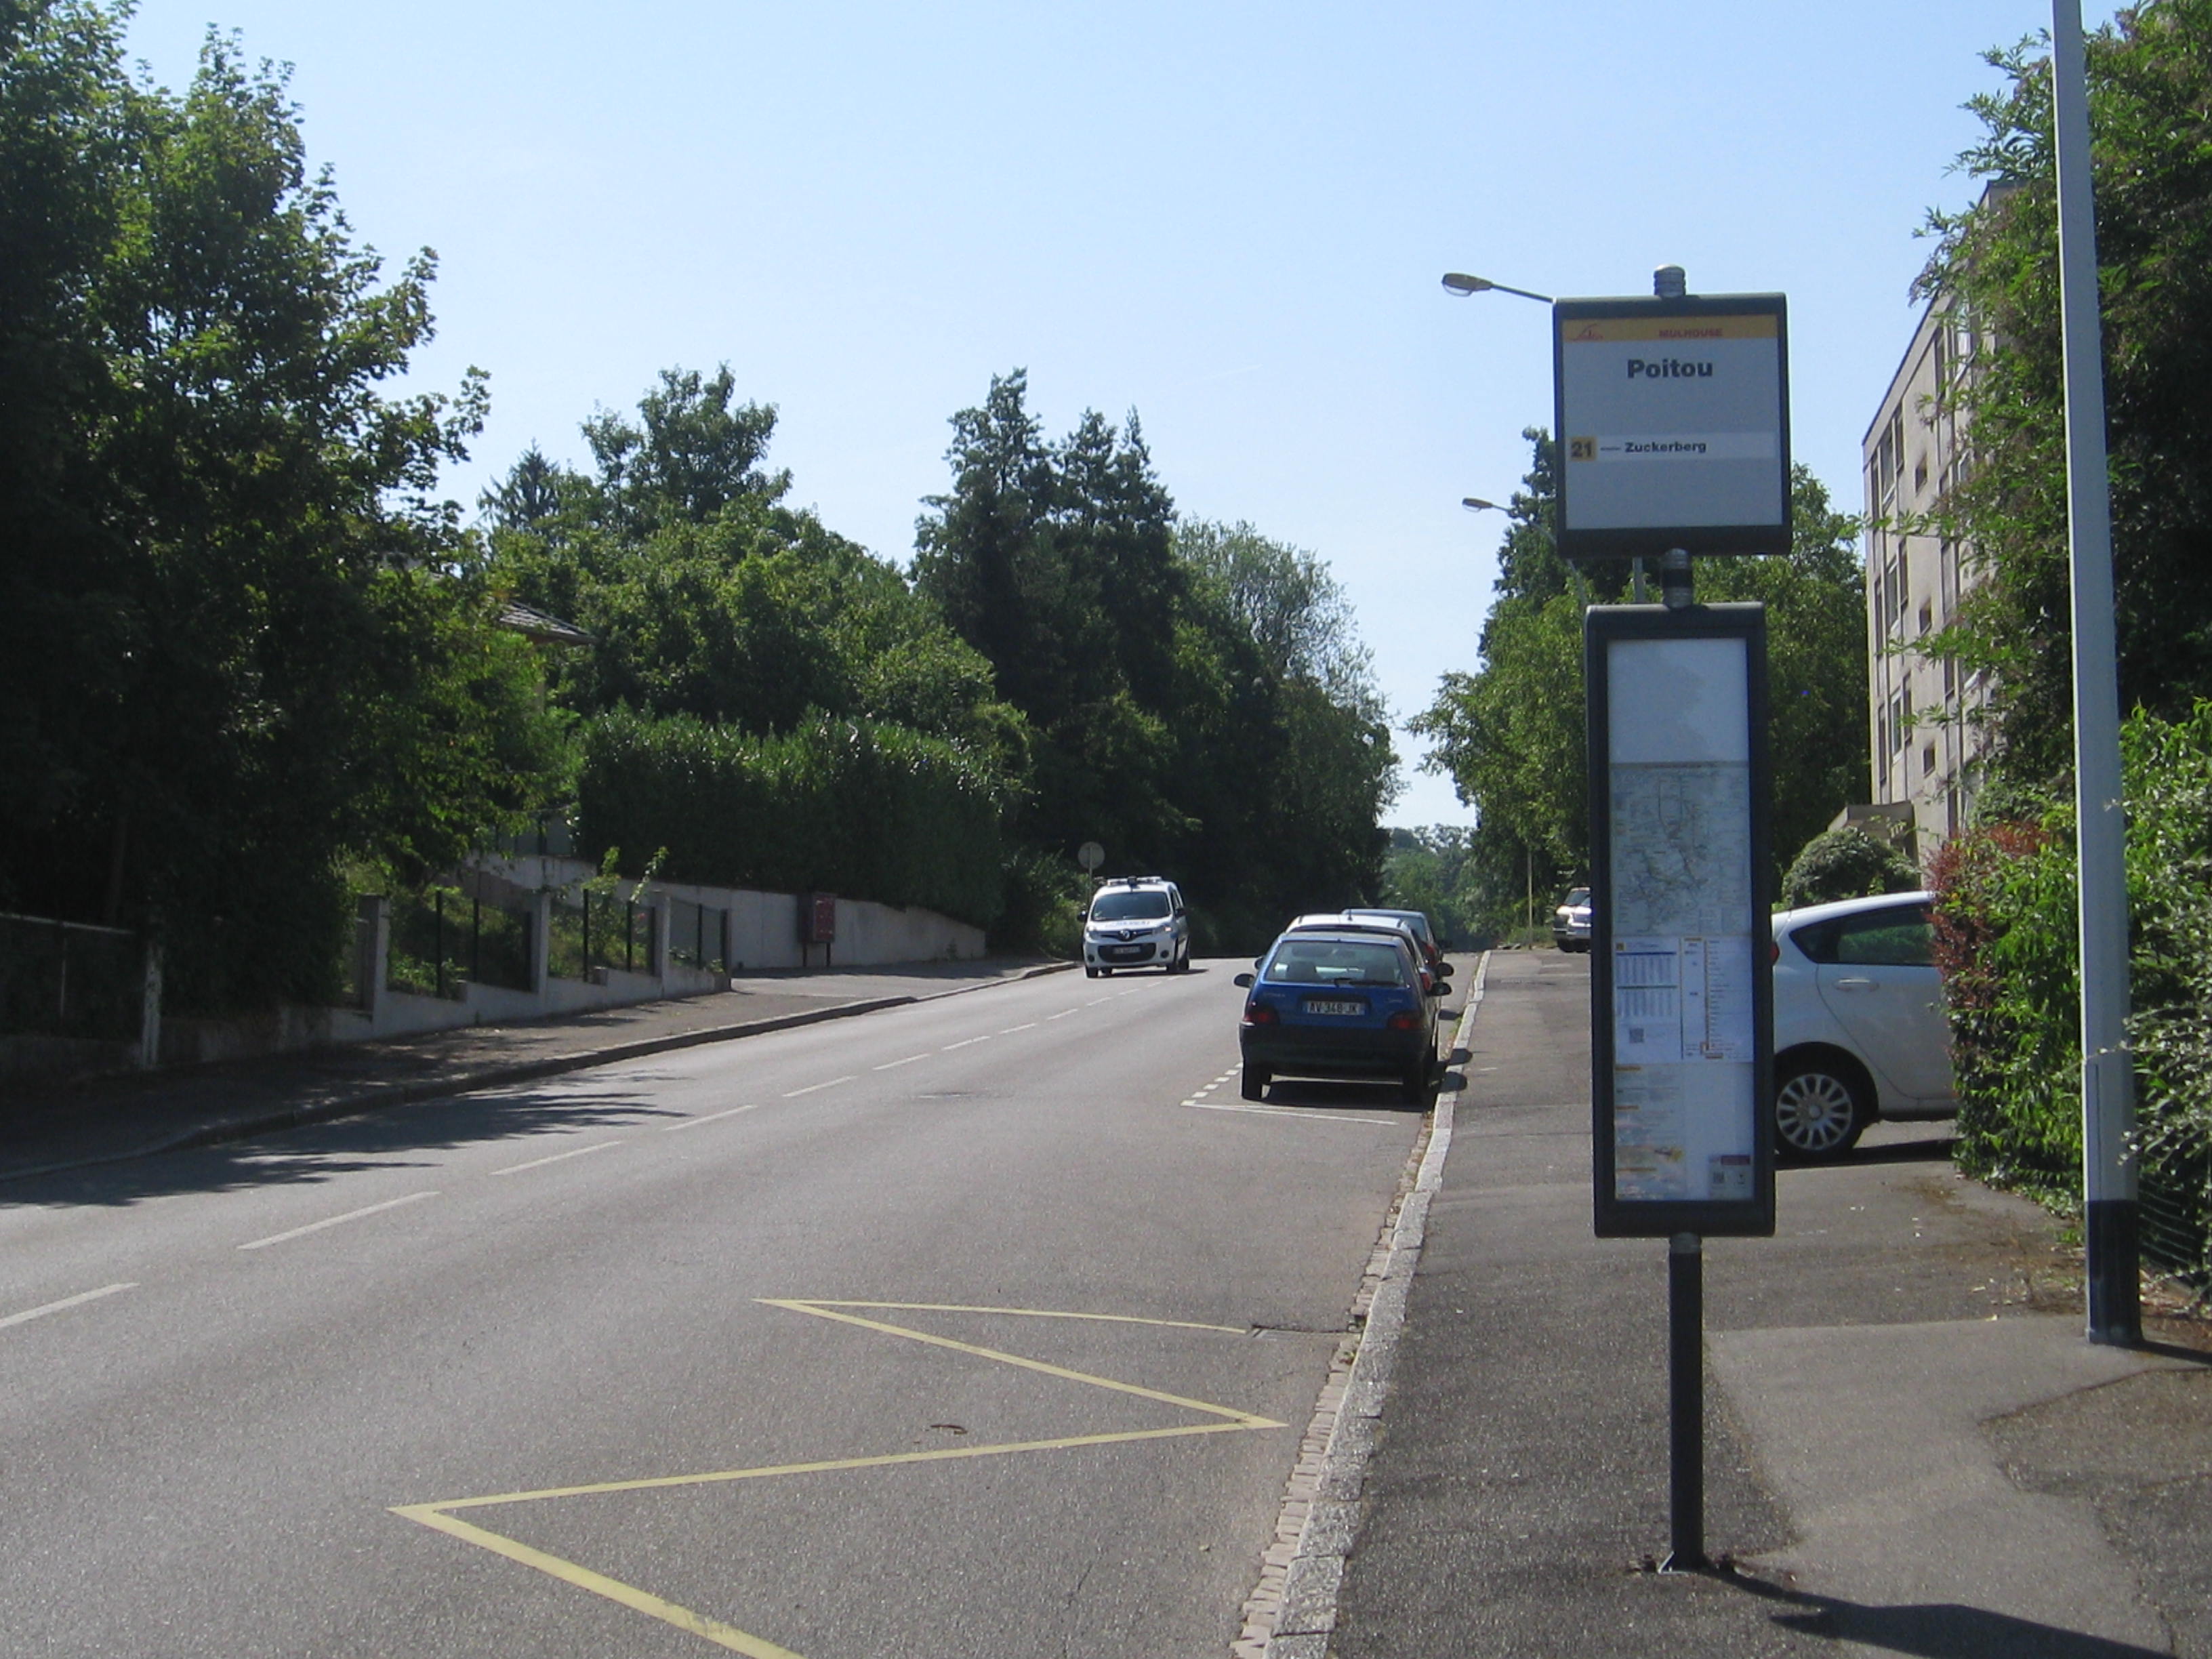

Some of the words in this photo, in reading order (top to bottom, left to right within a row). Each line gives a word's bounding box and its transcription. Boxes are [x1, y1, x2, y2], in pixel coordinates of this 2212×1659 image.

[1659, 328, 1723, 338] MULHOUSE
[1628, 359, 1713, 378] Poitou
[1571, 441, 1592, 458] 21
[1625, 441, 1706, 453] Zuckerberg
